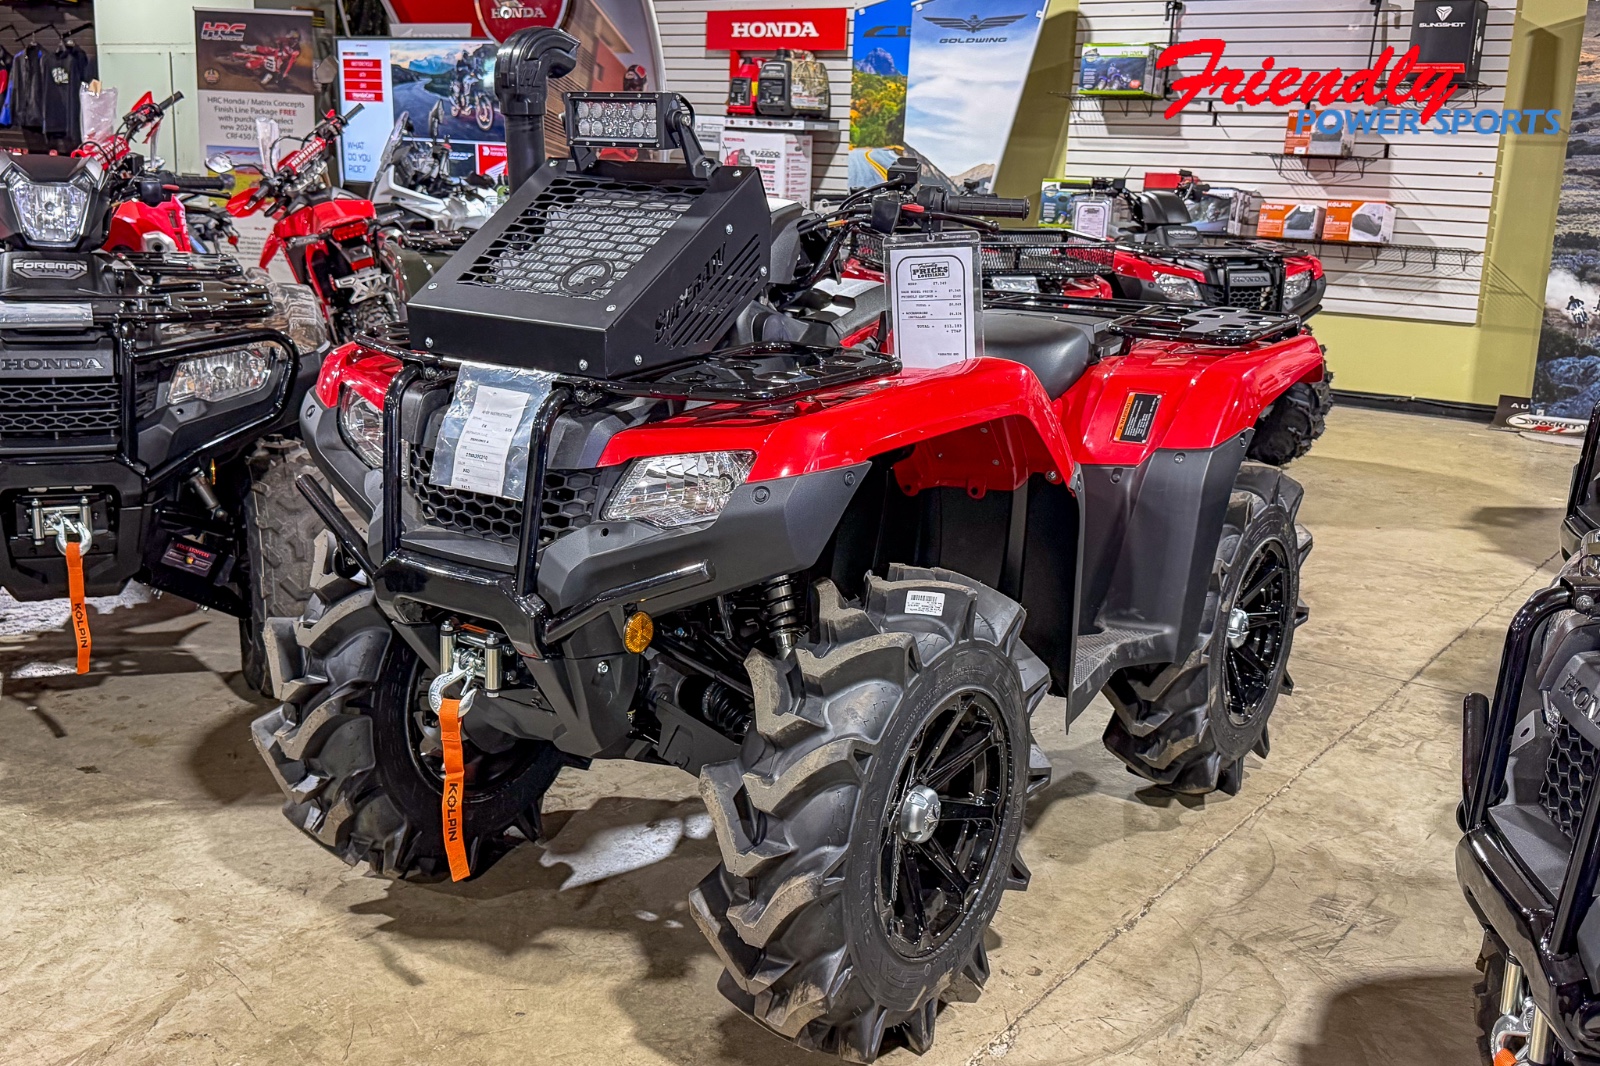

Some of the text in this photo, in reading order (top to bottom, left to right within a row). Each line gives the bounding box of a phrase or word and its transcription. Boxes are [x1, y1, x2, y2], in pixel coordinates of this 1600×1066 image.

[491, 6, 547, 19] HONDA
[201, 22, 246, 36] HRC
[730, 21, 819, 38] HONDA
[207, 96, 222, 105] HRC
[223, 97, 245, 105] Honda
[251, 98, 272, 106] Matrix
[273, 100, 305, 109] Concepts
[214, 105, 233, 113] Finish
[250, 106, 278, 116] Package
[218, 114, 233, 122] with
[347, 141, 365, 149] WHAT
[358, 153, 372, 162] YOU
[348, 164, 367, 173] RIDE?
[12, 261, 88, 271] FOREMAN
[912, 266, 949, 276] PRICES
[1, 358, 104, 371] HONDA
[1531, 419, 1580, 430] ROCKET
[74, 602, 89, 649] KOLPIN
[1558, 672, 1600, 731] HON
[446, 782, 459, 842] KOLPIN
